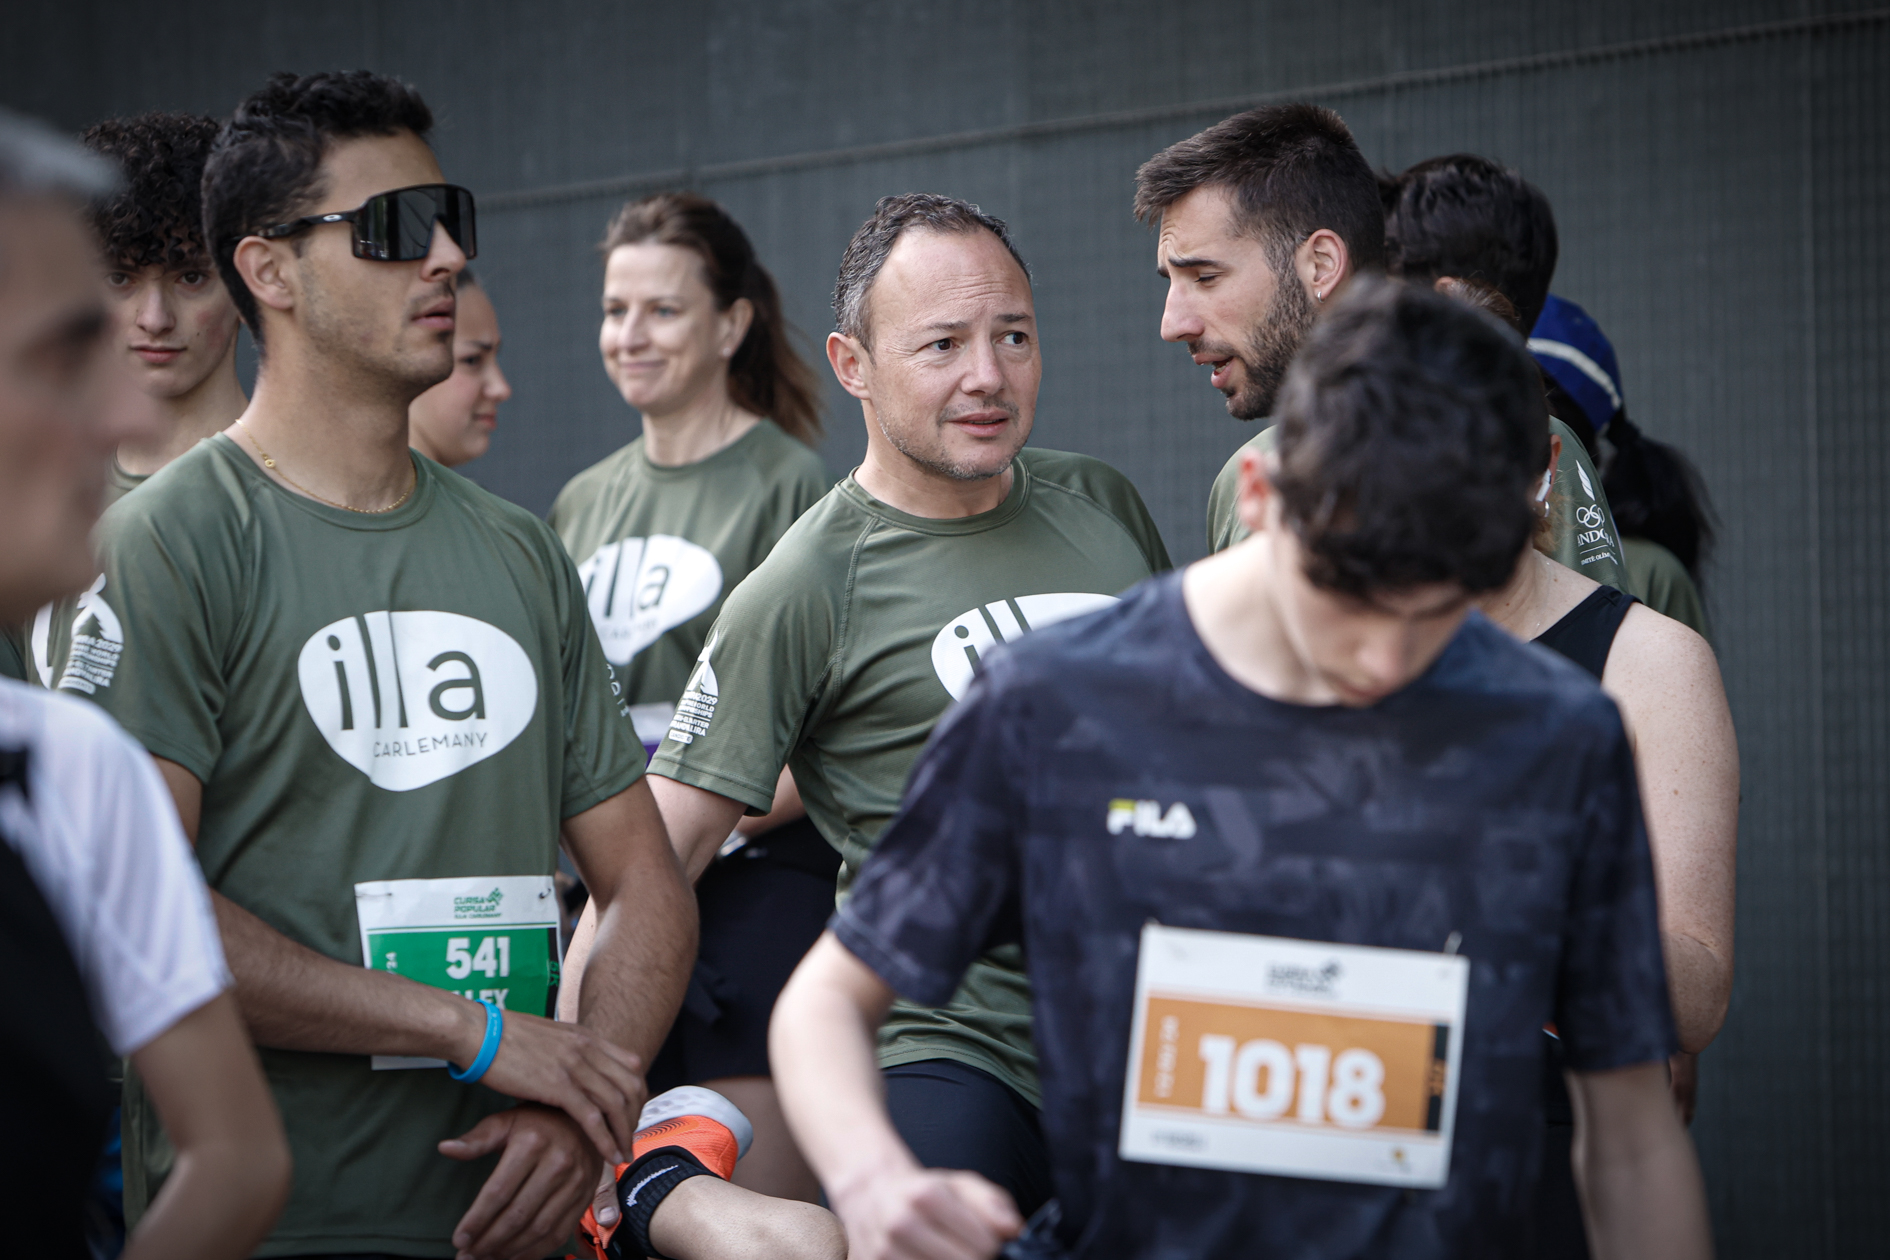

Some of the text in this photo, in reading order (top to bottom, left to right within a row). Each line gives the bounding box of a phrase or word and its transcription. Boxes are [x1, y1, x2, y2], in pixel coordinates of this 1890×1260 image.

[326, 611, 486, 730] illa
[697, 694, 718, 706] 2029
[374, 732, 487, 758] CARLEMANY
[1107, 798, 1196, 839] FILA
[447, 936, 510, 979] 541
[1199, 1034, 1385, 1129] 1018
